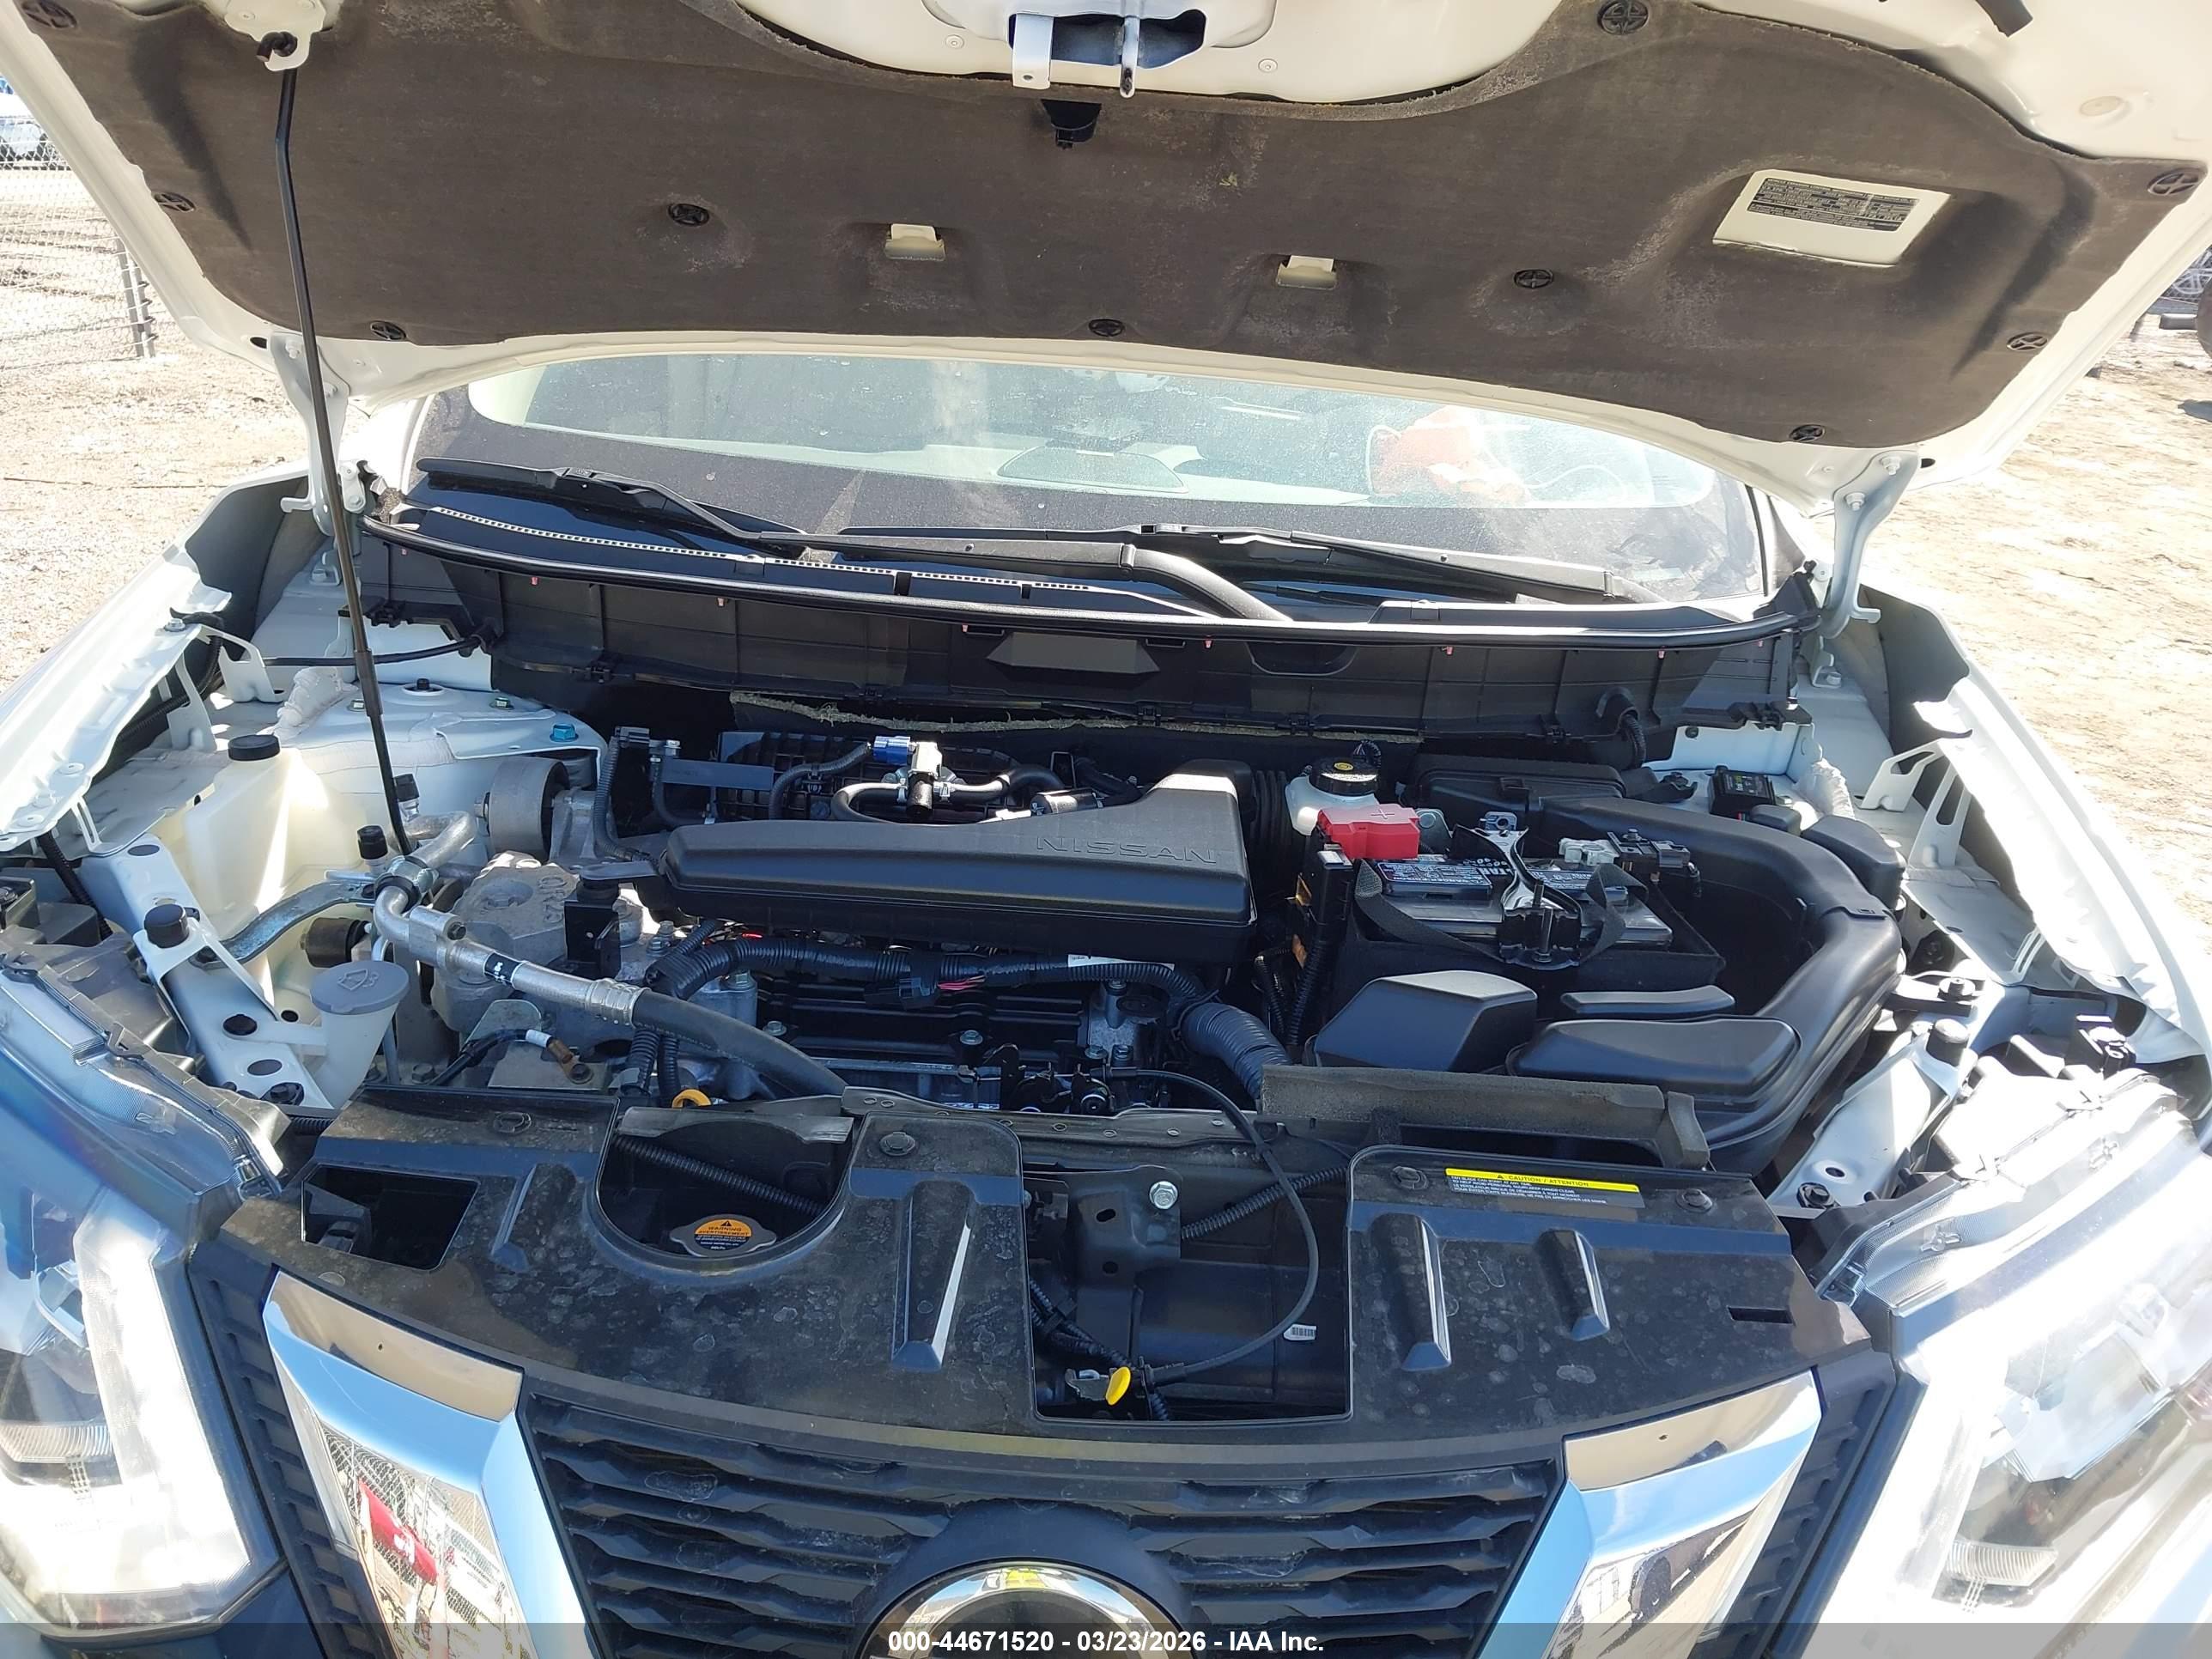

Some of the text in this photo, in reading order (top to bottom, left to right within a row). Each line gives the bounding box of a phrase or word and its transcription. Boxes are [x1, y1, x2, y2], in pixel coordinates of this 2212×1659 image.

[1036, 837, 1217, 864] NISSAN
[1509, 1175, 1541, 1183] CAUTION
[1549, 1178, 1589, 1187] ATTENTION
